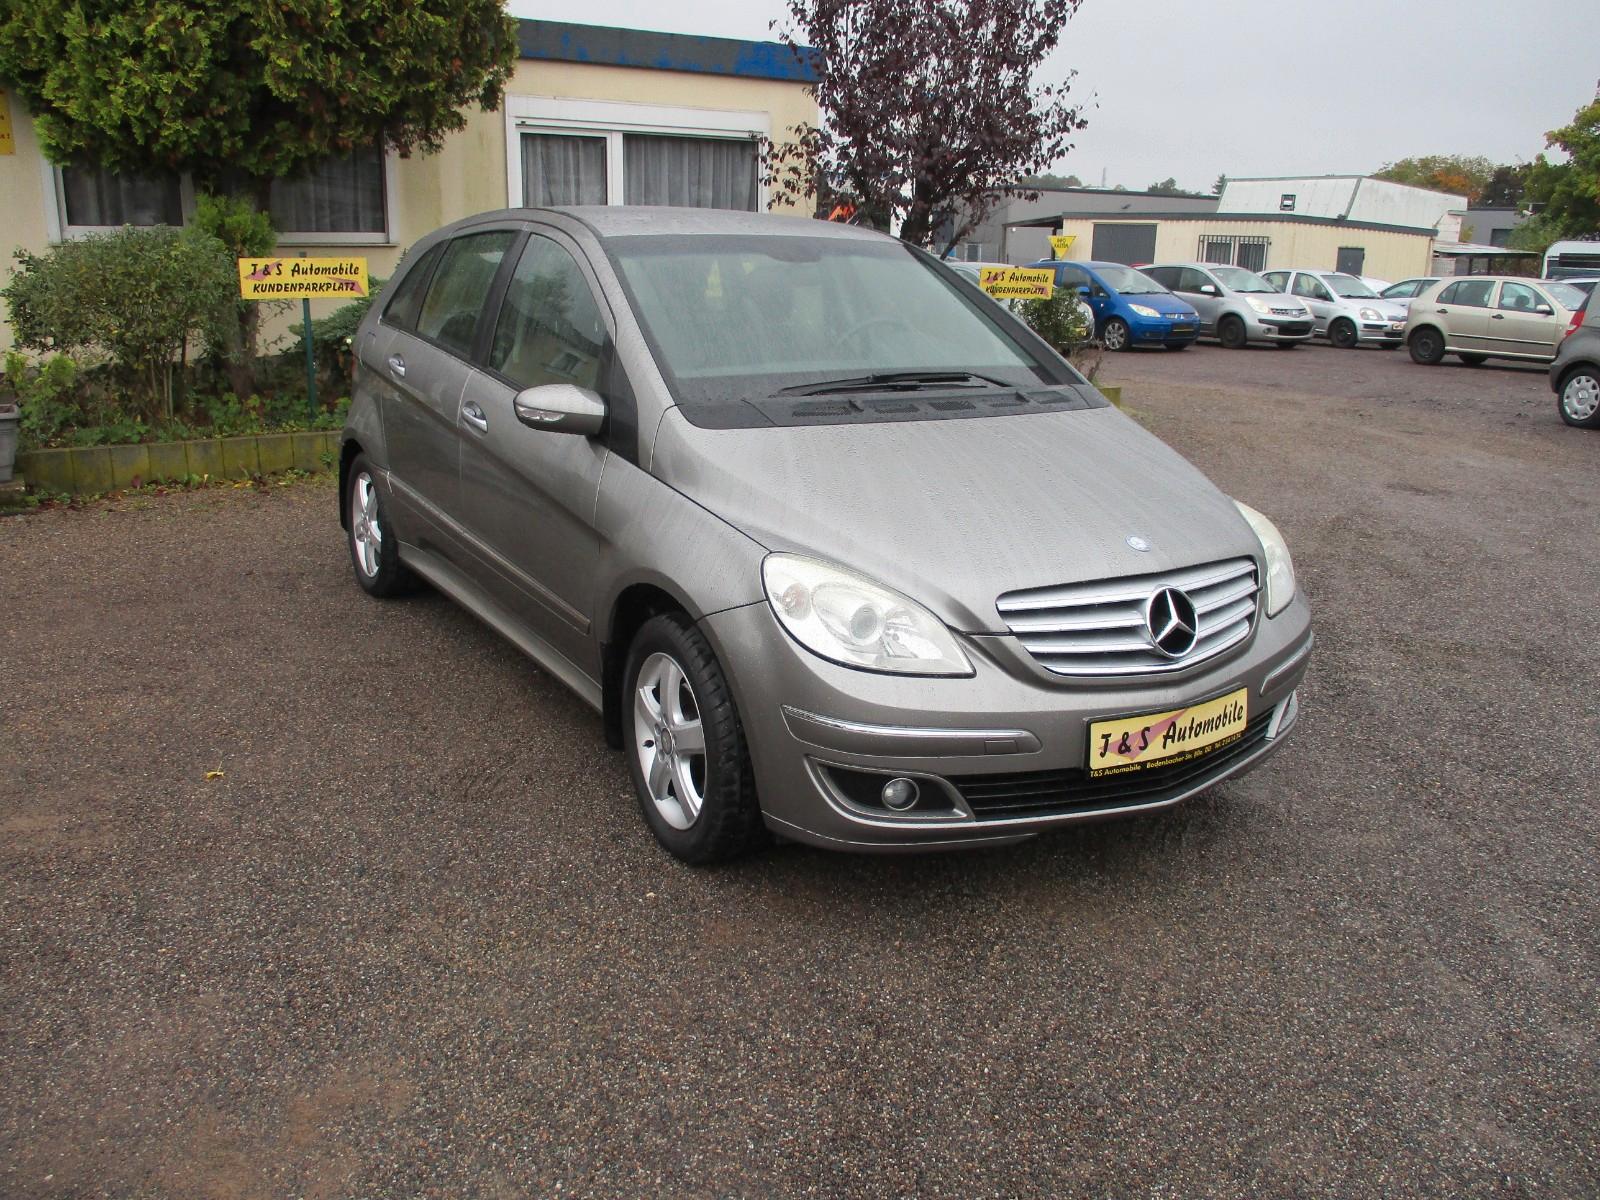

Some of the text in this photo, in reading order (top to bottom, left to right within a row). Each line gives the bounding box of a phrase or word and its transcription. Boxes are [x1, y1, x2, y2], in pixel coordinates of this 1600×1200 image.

[262, 264, 271, 276] &
[276, 263, 282, 275] S
[291, 263, 360, 277] Automobile
[1000, 272, 1005, 281] S
[1009, 271, 1049, 283] Automobile
[253, 282, 356, 293] KUNDENPARKPLATZ
[985, 285, 1045, 295] KUNDENPARKPLATZ
[1117, 731, 1132, 754] &
[1138, 726, 1151, 751] S
[1162, 700, 1244, 750] Automobile
[1104, 764, 1142, 776] Automobile
[1146, 755, 1184, 769] Bodenbacher
